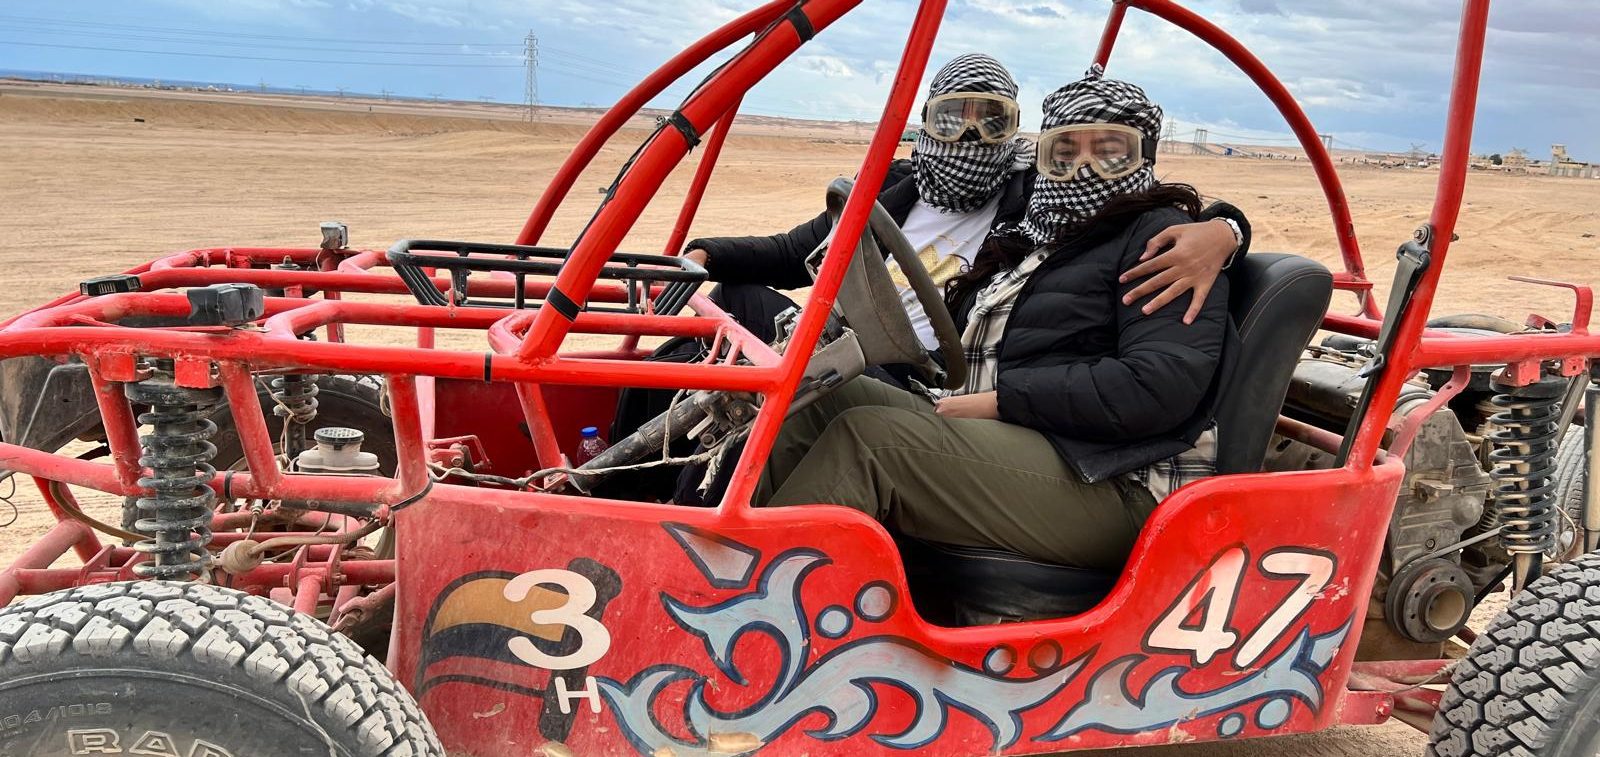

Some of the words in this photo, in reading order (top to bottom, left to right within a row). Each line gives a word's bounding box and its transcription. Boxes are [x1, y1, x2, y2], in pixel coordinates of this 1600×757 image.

[503, 568, 611, 669] 3
[1141, 542, 1337, 670] 47
[555, 675, 601, 714] H
